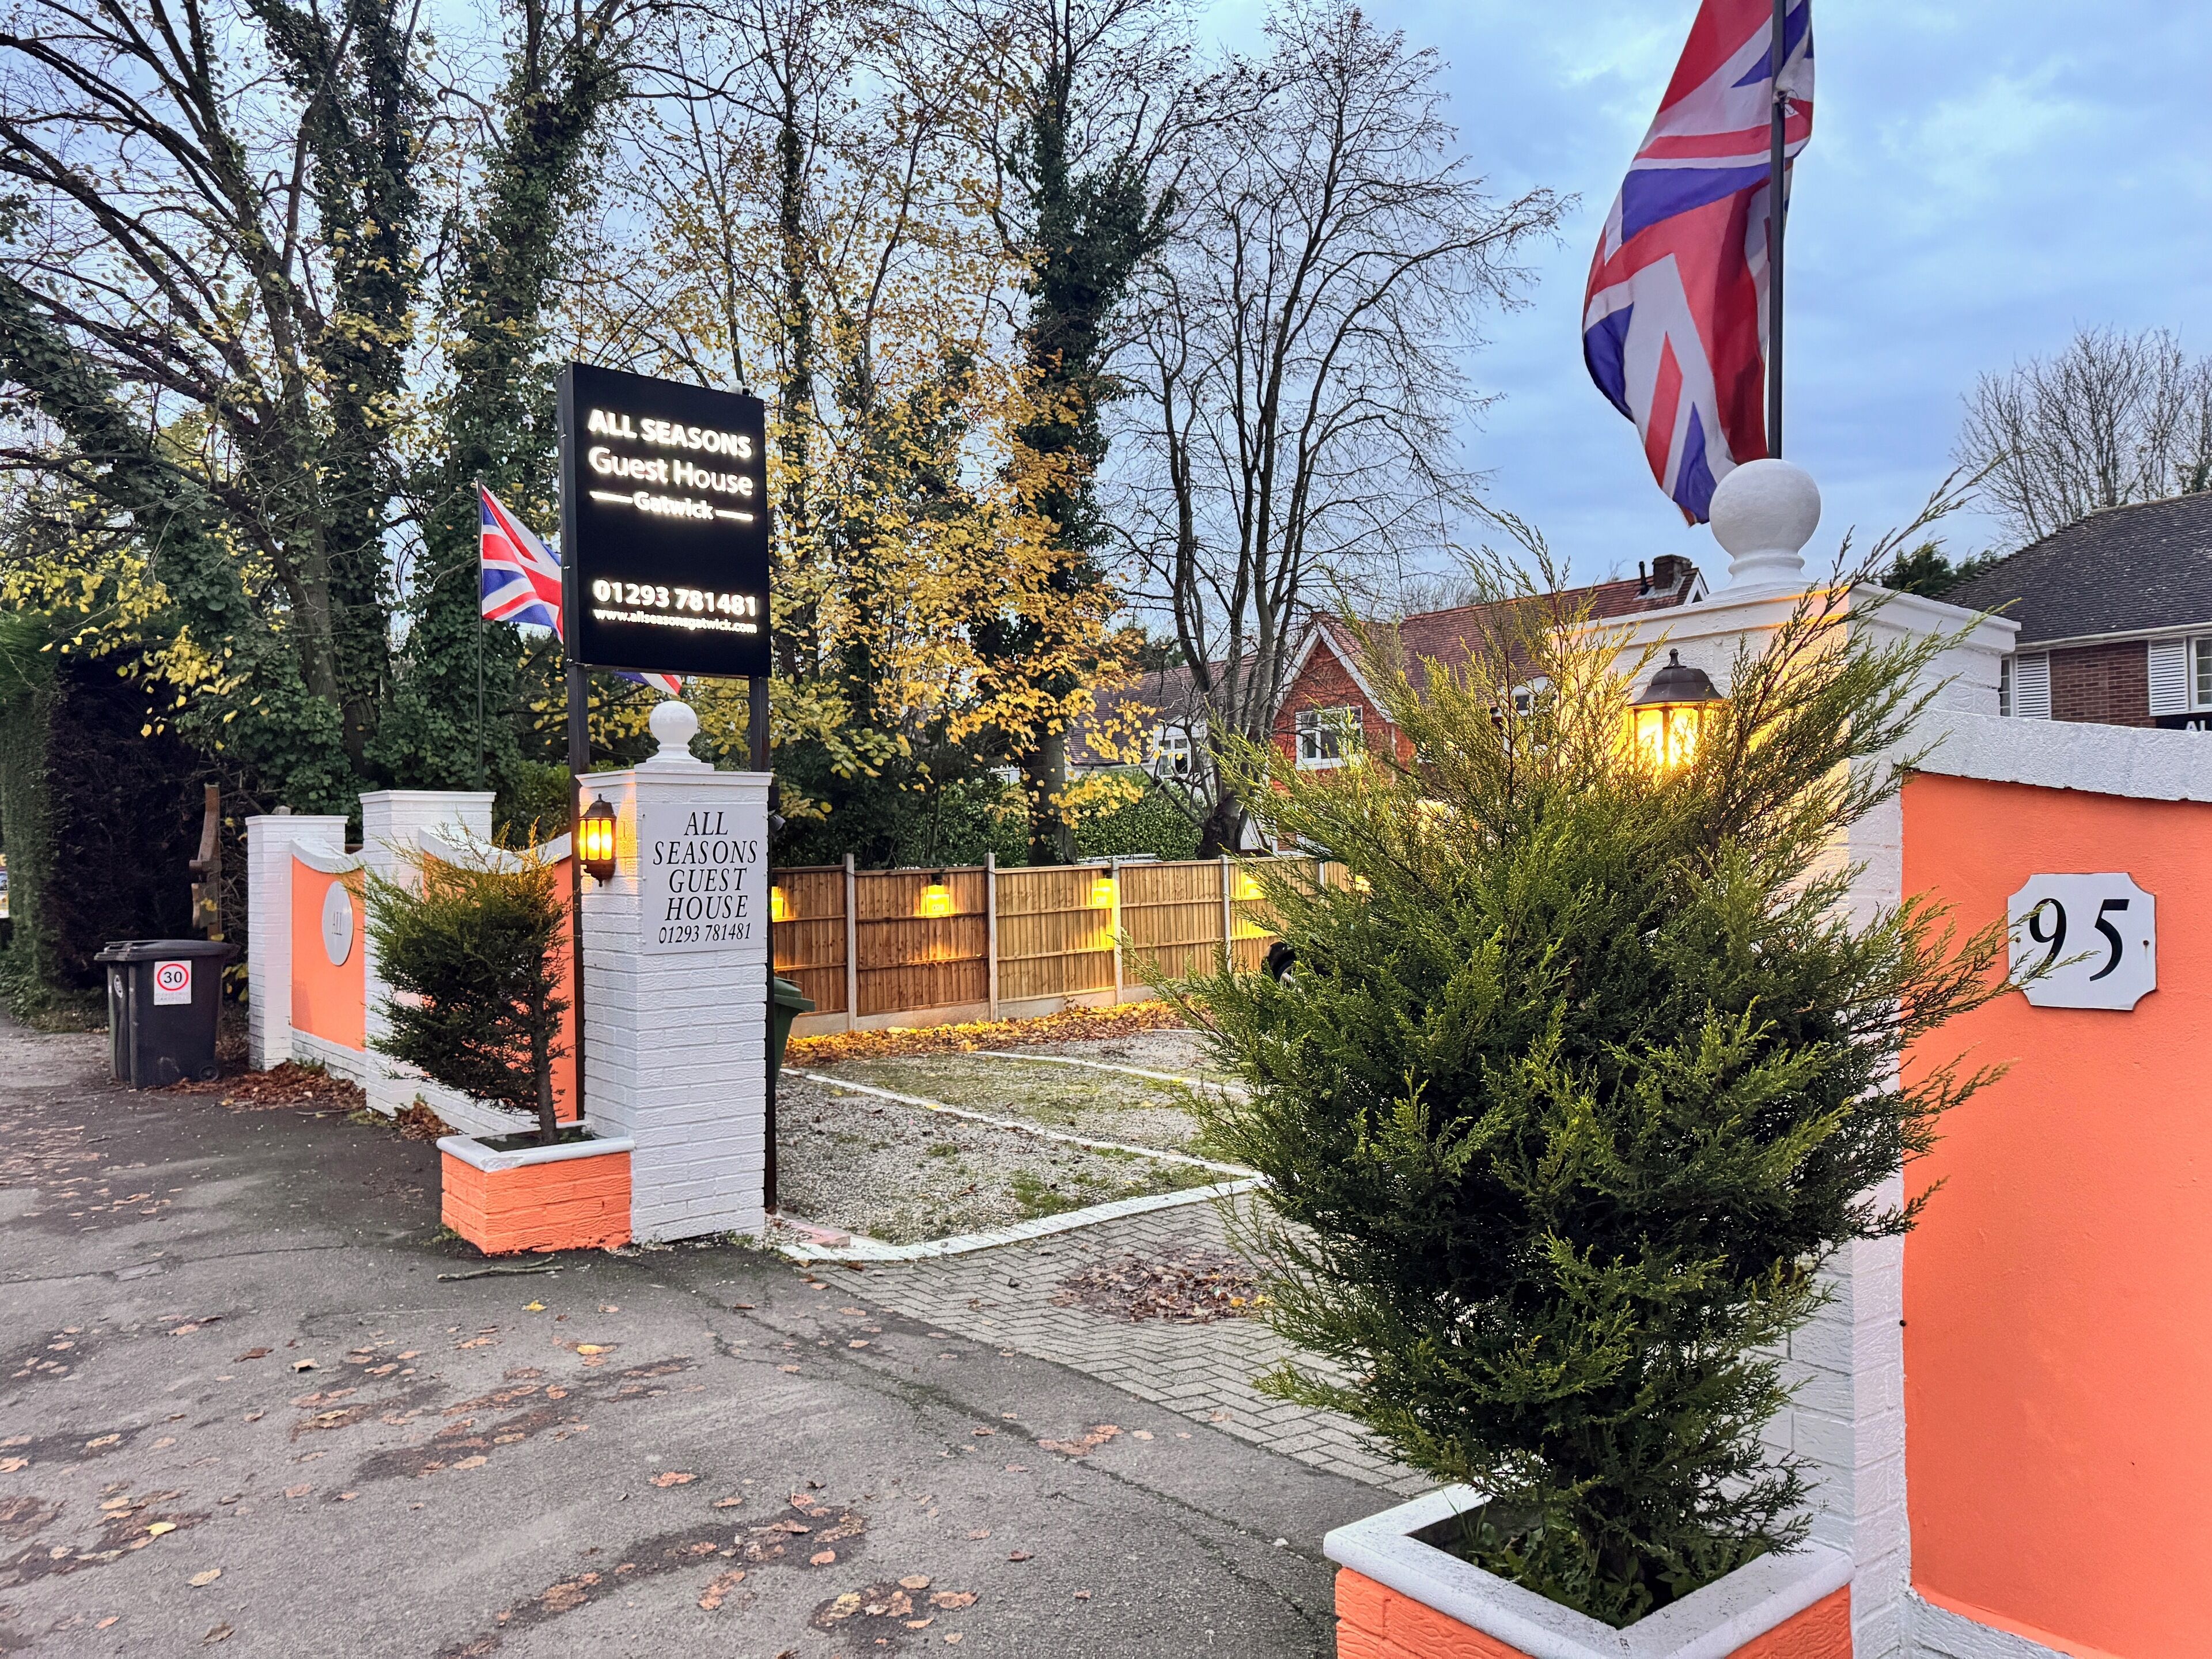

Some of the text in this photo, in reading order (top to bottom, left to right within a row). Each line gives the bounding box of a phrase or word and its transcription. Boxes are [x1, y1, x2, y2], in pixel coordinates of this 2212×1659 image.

[588, 409, 752, 458] ALL SEASONS
[589, 446, 753, 496] Guest House
[634, 491, 714, 520] Gatwick
[593, 579, 756, 616] 01293 781481
[684, 811, 728, 836] ALL
[653, 840, 758, 865] SEASONS
[669, 867, 747, 893] GUEST
[665, 895, 748, 921] HOUSE
[658, 922, 751, 944] 01293 781481
[2027, 897, 2130, 982] 95
[164, 971, 182, 983] 30
